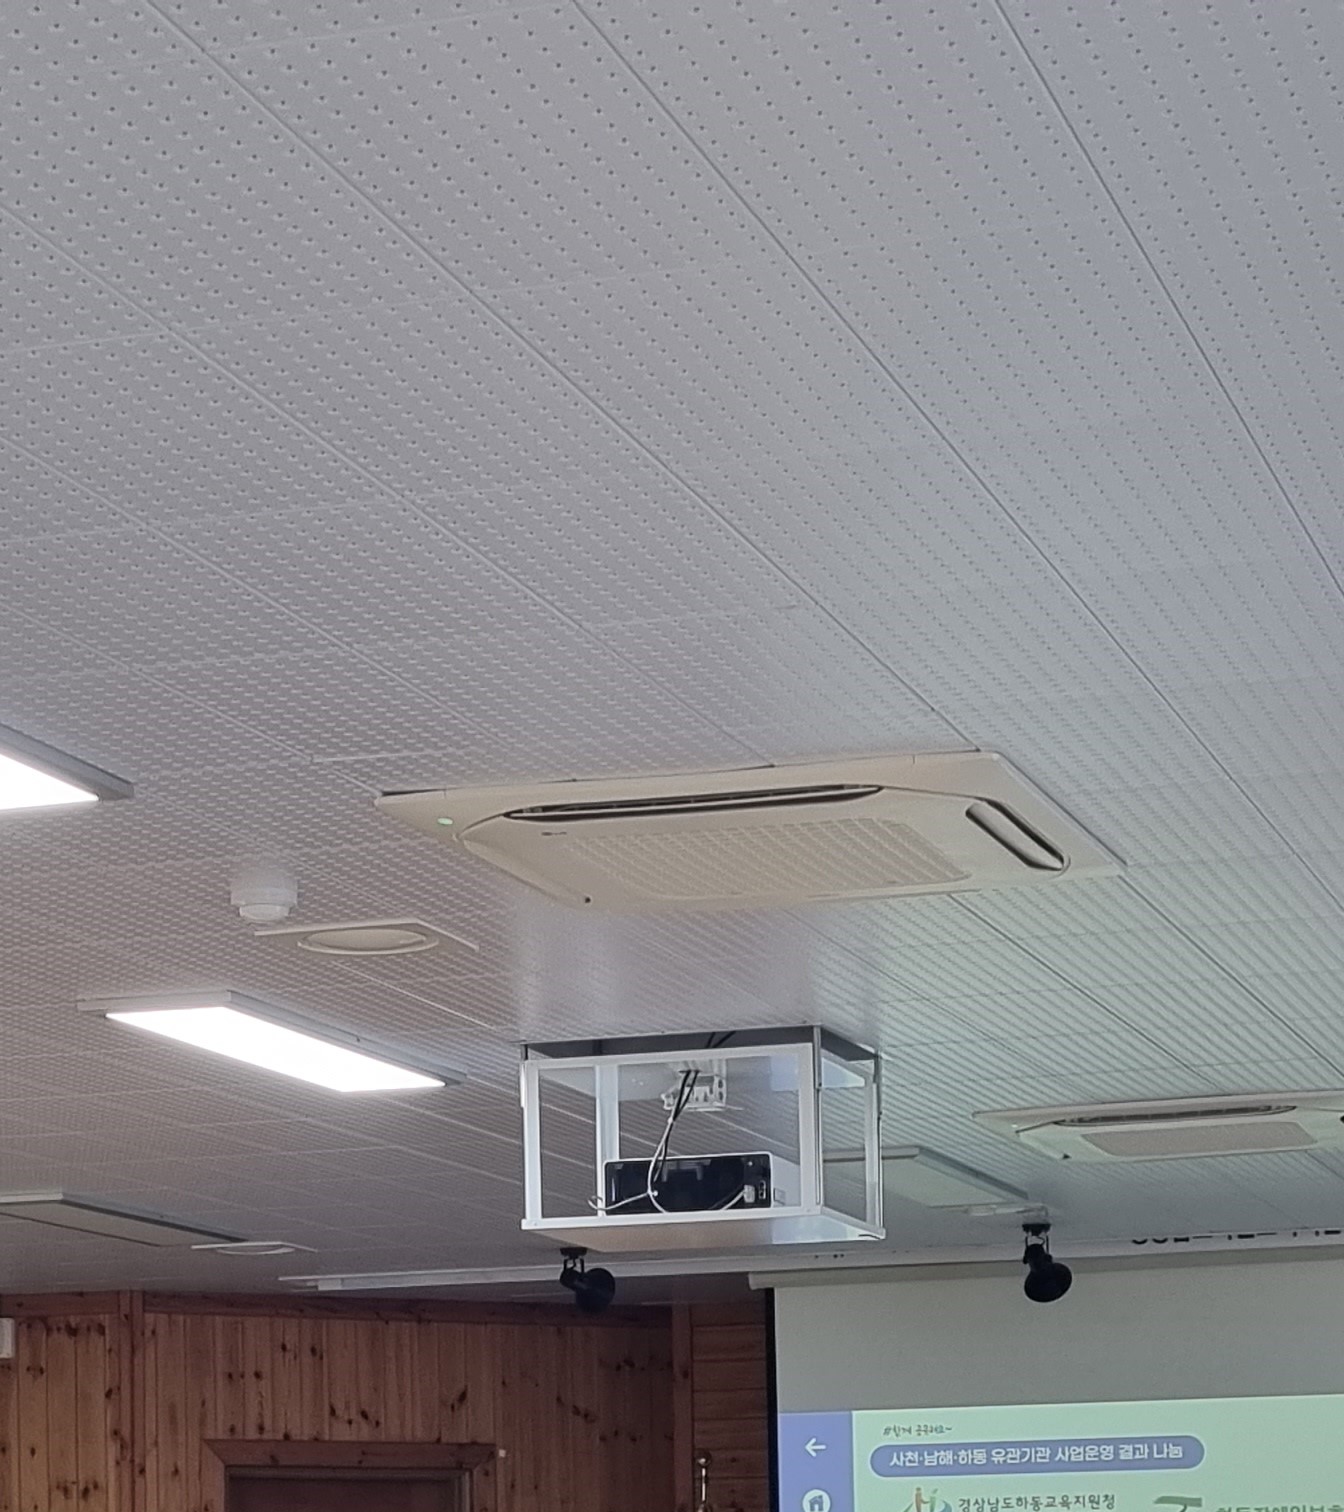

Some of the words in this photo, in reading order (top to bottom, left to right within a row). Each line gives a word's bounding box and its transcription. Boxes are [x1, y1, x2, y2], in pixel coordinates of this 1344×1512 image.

[889, 1449, 988, 1467] 사천·남해·하동
[991, 1447, 1051, 1464] 유관기관
[1054, 1445, 1115, 1462] 사업운영
[1118, 1444, 1149, 1461] 결과
[1152, 1442, 1183, 1459] 나눔
[958, 1494, 1116, 1511] 경상남도하동교육지원청
